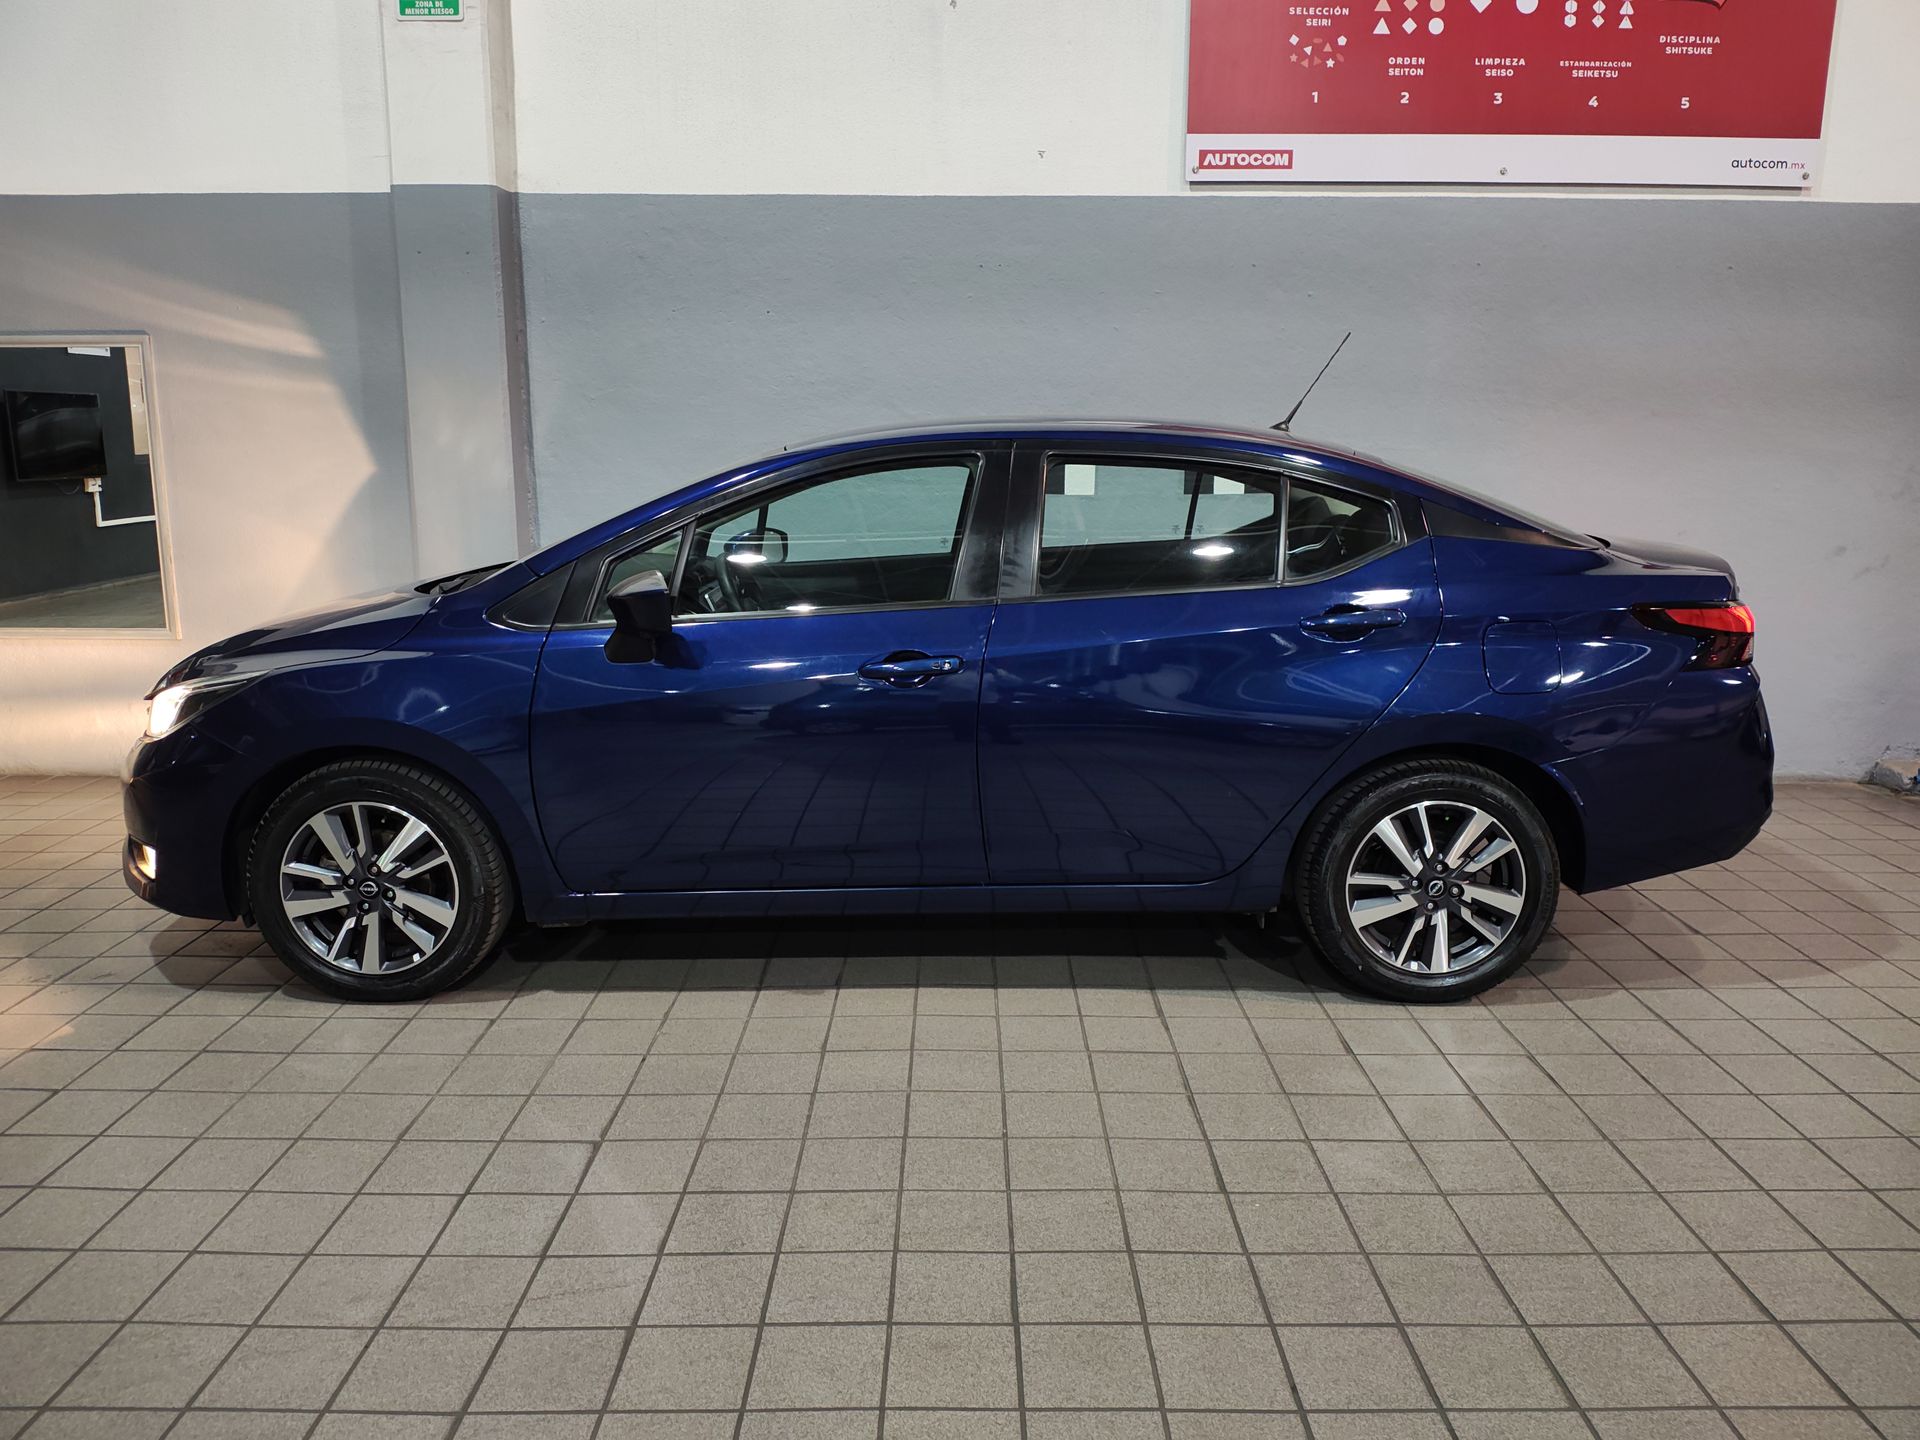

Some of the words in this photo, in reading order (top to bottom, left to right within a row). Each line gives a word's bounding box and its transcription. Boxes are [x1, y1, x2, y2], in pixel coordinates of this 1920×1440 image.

[405, 7, 429, 15] MENOR
[430, 7, 455, 15] RIESGO
[1288, 5, 1350, 16] SELECCIÓN
[1305, 17, 1332, 27] SEIRI
[1659, 35, 1721, 44] DISCIPLINA
[1665, 46, 1713, 55] SHITSUKE
[1388, 56, 1426, 65] ORDEN
[1474, 57, 1526, 66] LIMPIEZA
[1559, 59, 1632, 68] ESTANDARIZACIÓN
[1388, 67, 1424, 76] SEITON
[1485, 68, 1514, 77] SEISO
[1572, 69, 1619, 78] SEIKETSU
[1311, 91, 1319, 104] 1
[1400, 91, 1410, 104] 2
[1493, 92, 1503, 105] 3
[1588, 95, 1599, 108] 4
[1680, 96, 1690, 109] 5
[1202, 152, 1290, 166] AUTOCOM
[1731, 157, 1806, 170] autocom.mx
